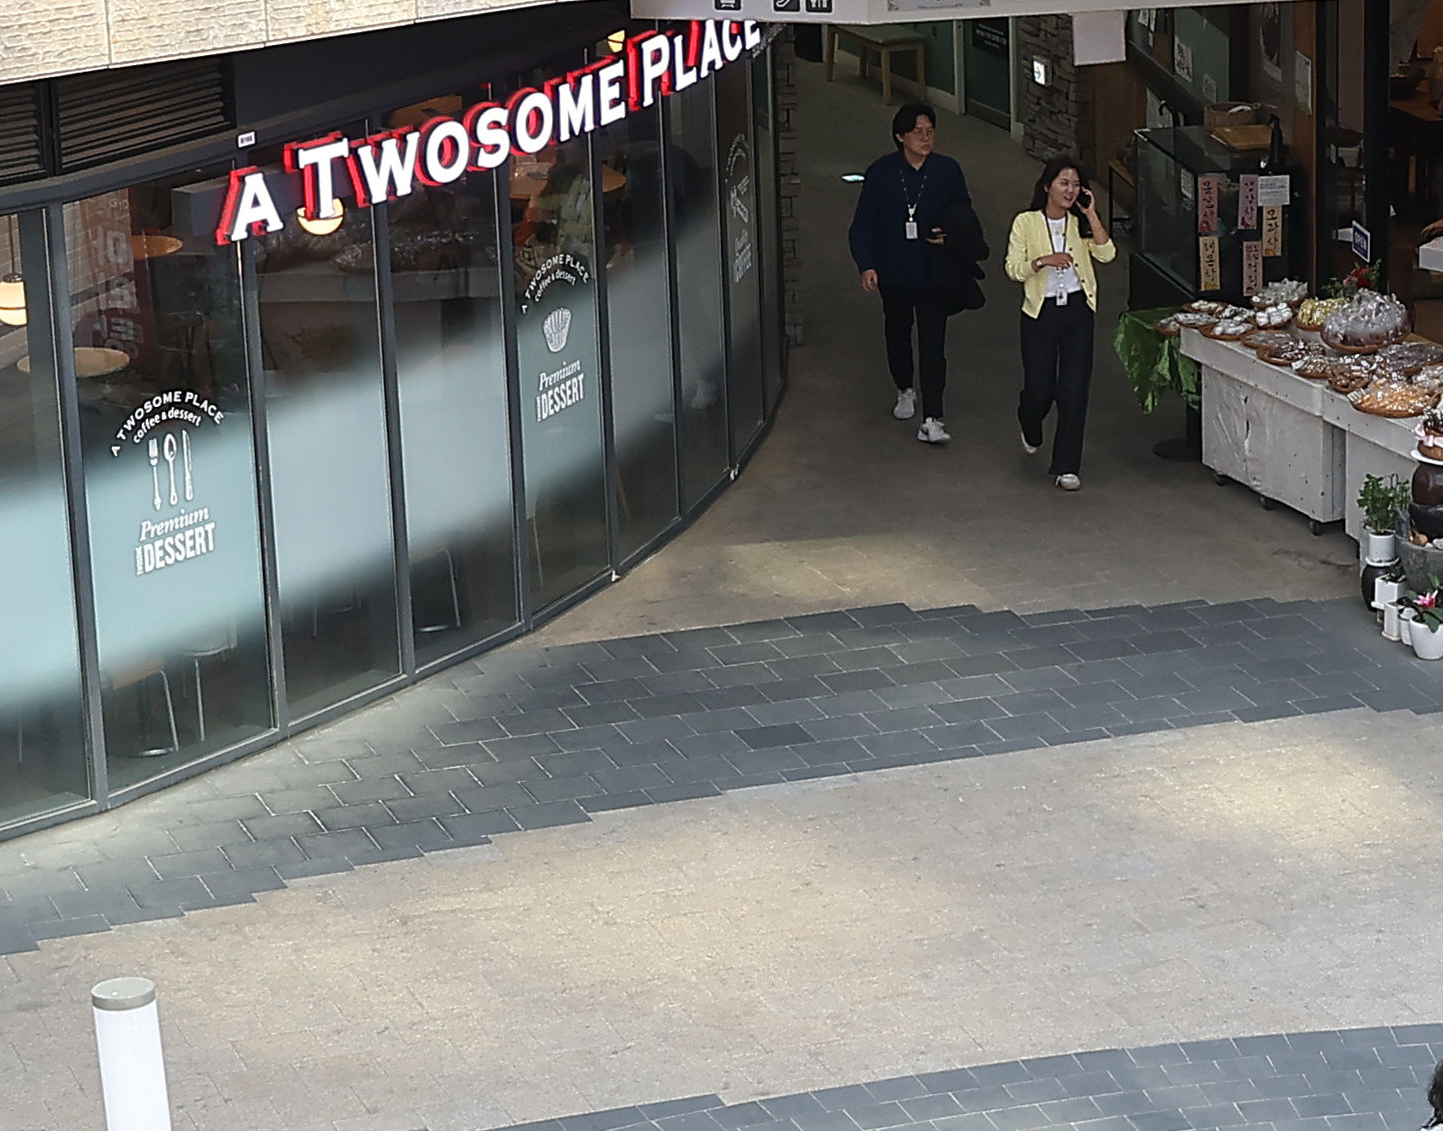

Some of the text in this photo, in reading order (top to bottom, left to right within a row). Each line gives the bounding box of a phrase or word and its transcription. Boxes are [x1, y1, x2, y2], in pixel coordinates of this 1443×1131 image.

[230, 170, 286, 243] A
[298, 60, 627, 222] TWOSOME
[641, 19, 761, 108] PLACE
[525, 254, 590, 300] TWOSOME PLACE
[539, 360, 581, 391] Premium
[541, 373, 585, 421] DESSERT
[116, 391, 182, 440] TWOSOME
[184, 391, 225, 425] PLACE
[133, 407, 203, 443] coffee dessert
[140, 508, 210, 542] Premium
[144, 522, 216, 573] DESSERT
